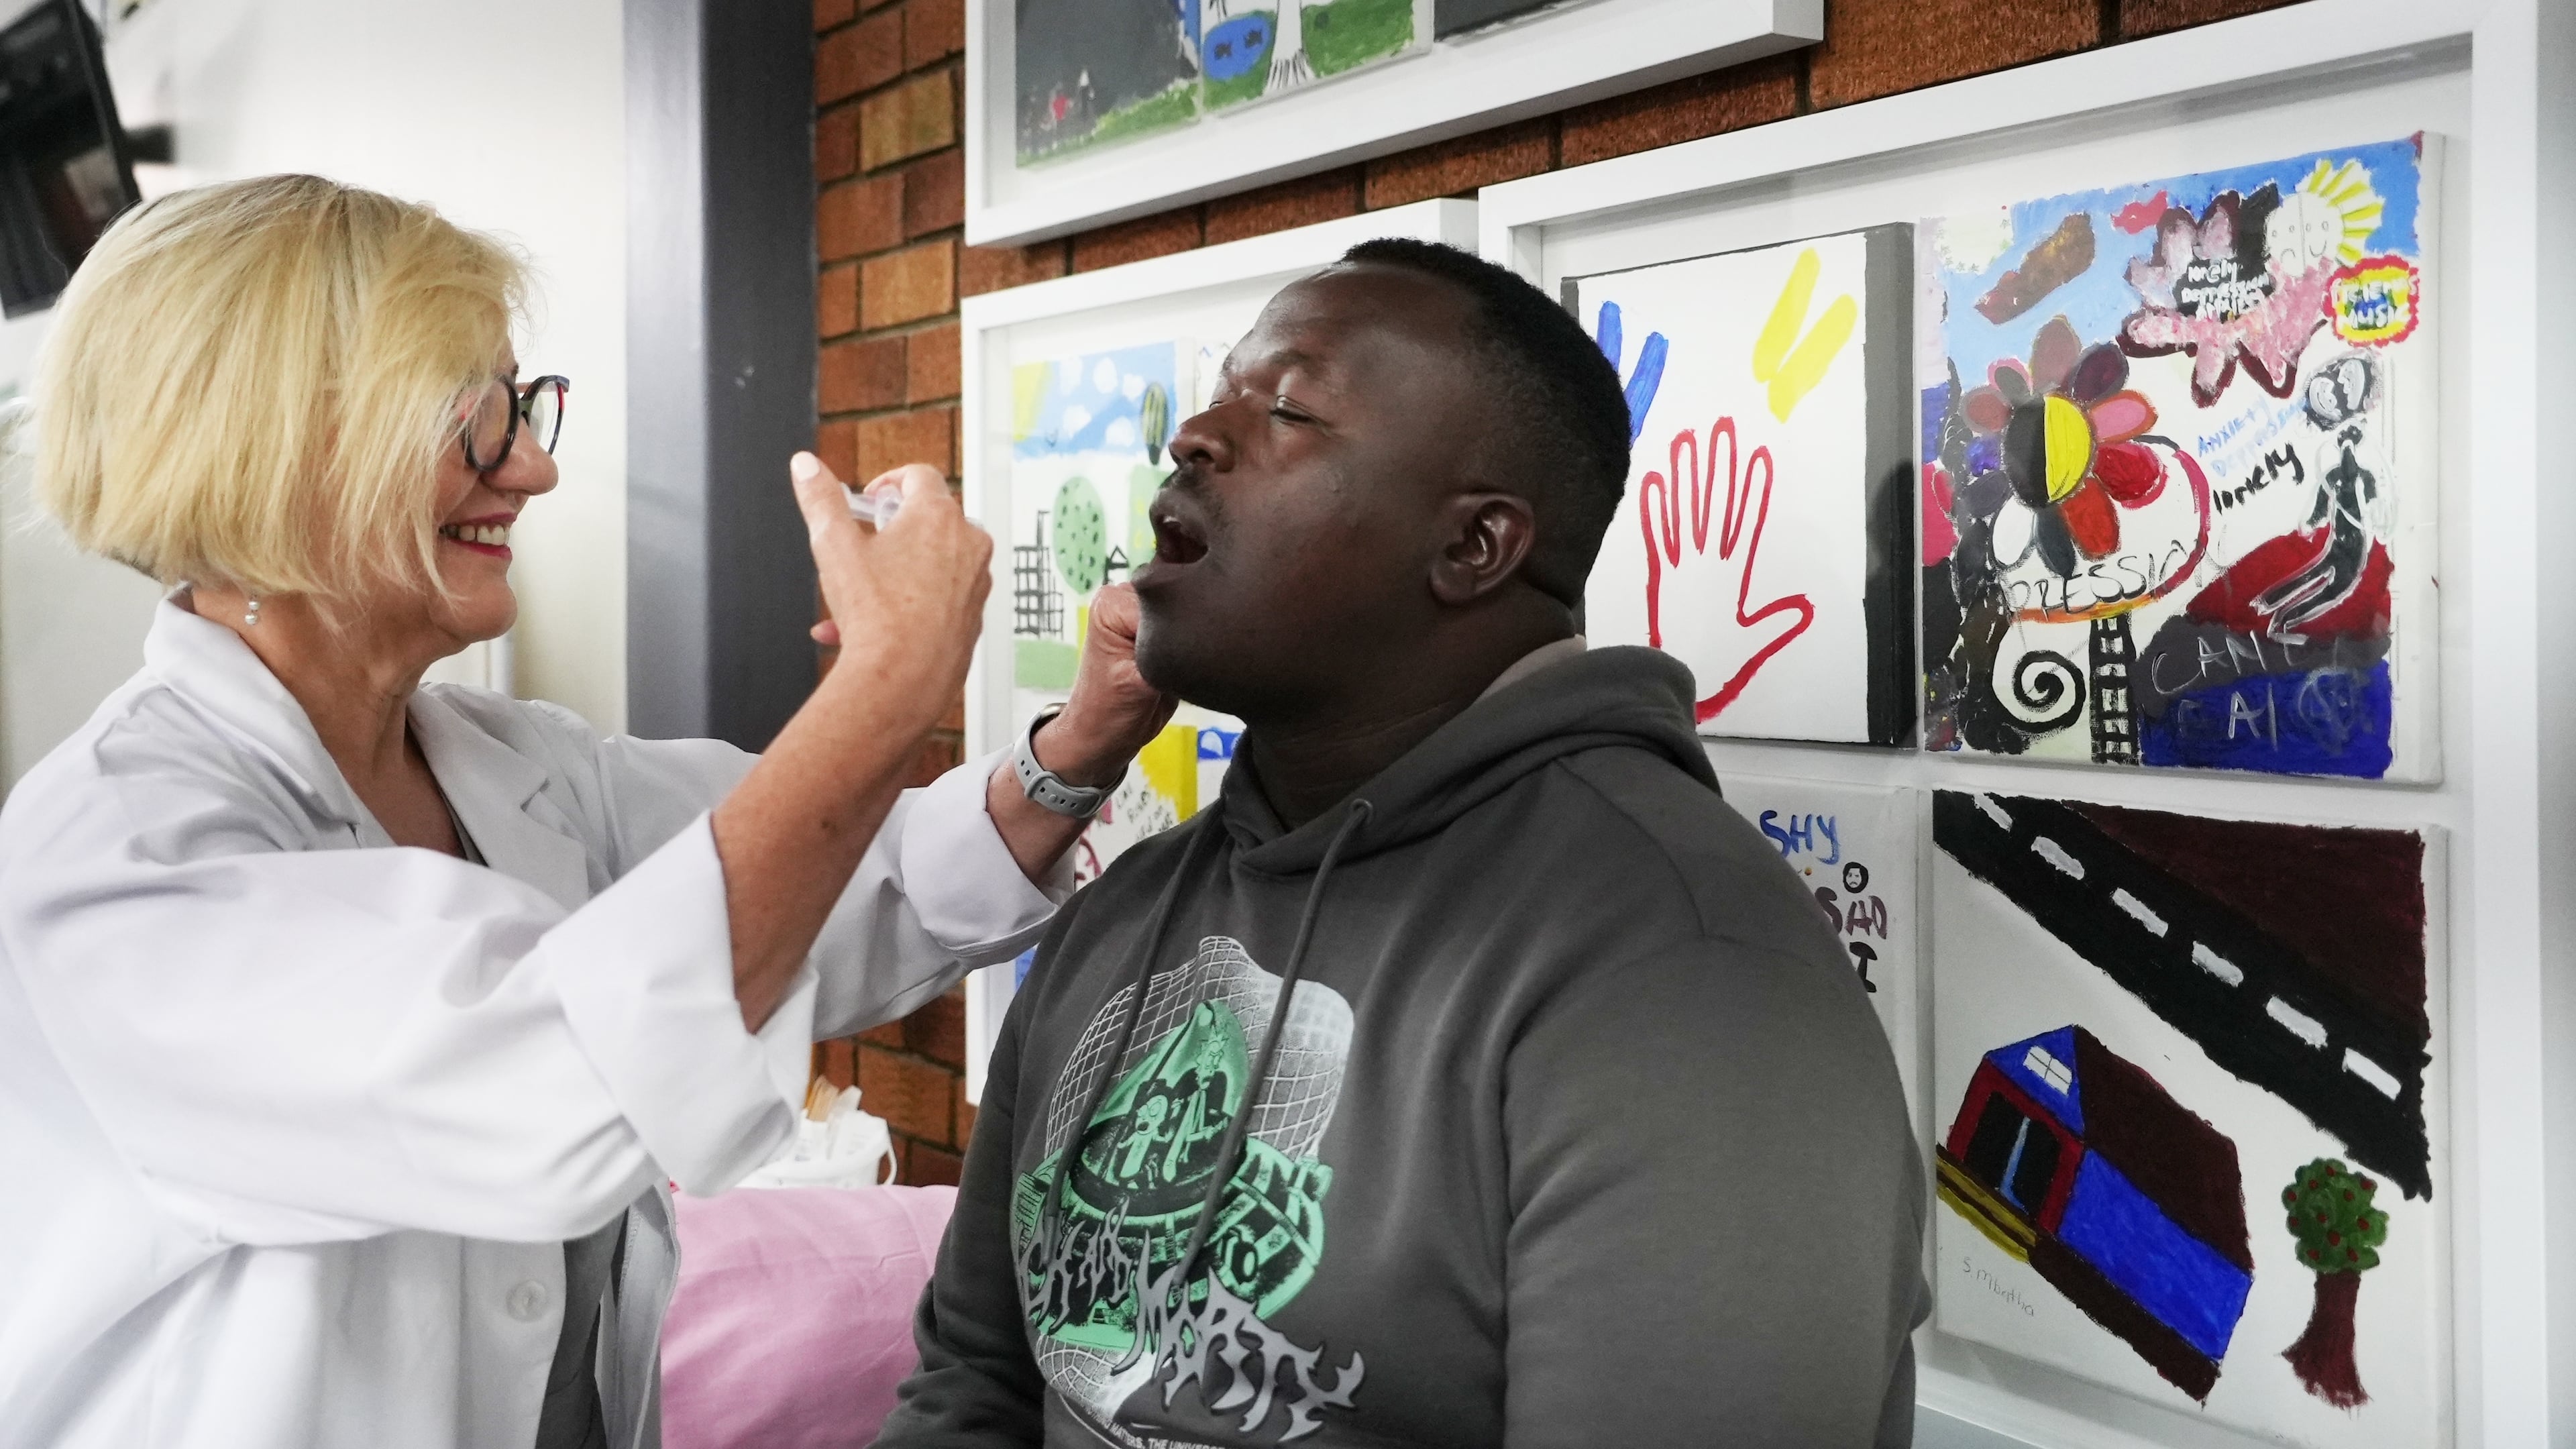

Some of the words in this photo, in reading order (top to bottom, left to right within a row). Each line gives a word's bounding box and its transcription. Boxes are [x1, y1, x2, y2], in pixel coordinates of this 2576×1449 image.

[1759, 810, 1841, 865] SHY
[1814, 886, 1888, 940] SAD
[1111, 1229, 1365, 1442] MORTY
[1148, 1438, 1169, 1449] THE
